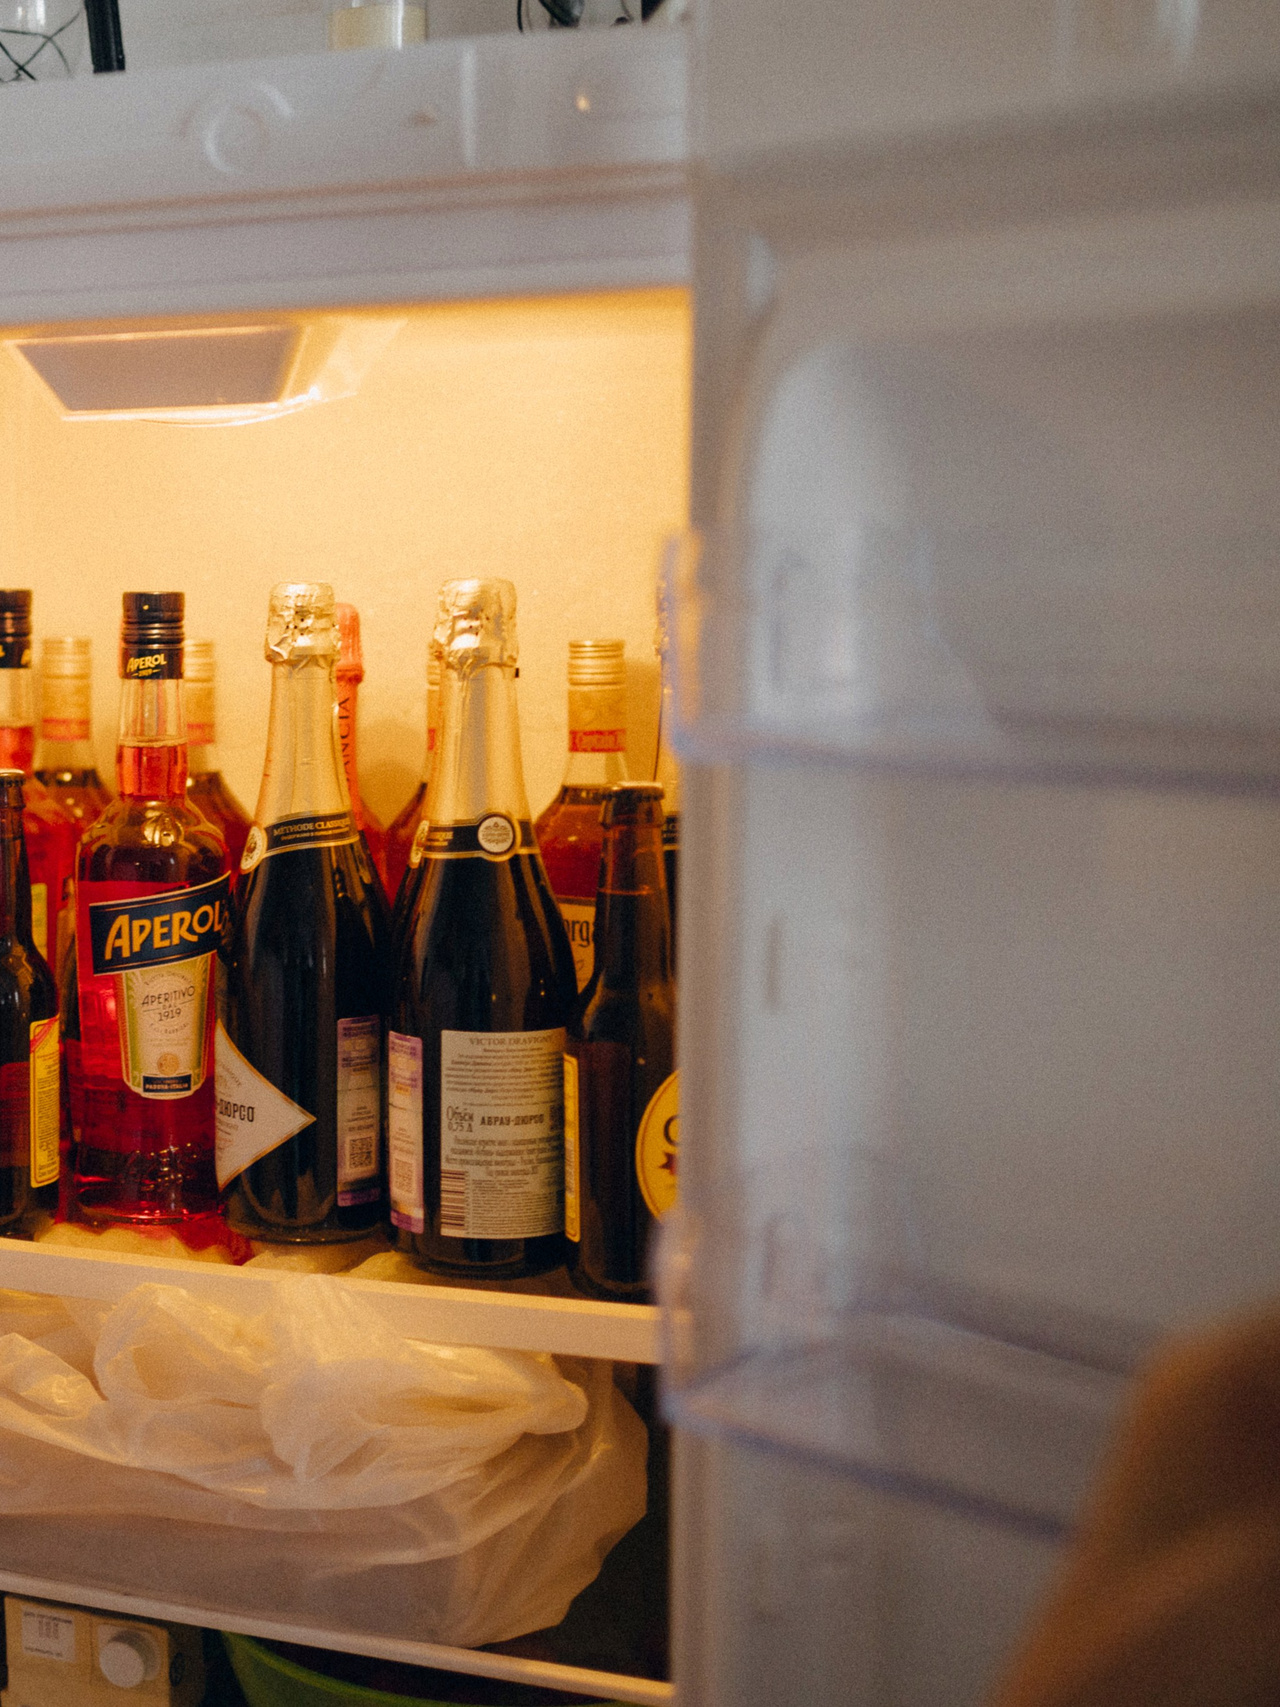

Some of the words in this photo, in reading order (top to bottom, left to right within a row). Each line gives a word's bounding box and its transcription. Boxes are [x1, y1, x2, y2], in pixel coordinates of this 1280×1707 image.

[126, 653, 168, 674] APEROL
[104, 901, 222, 961] APEROL
[142, 985, 195, 1006] APERITIVO
[158, 1008, 182, 1022] 1919
[469, 1037, 506, 1046] VICTOR
